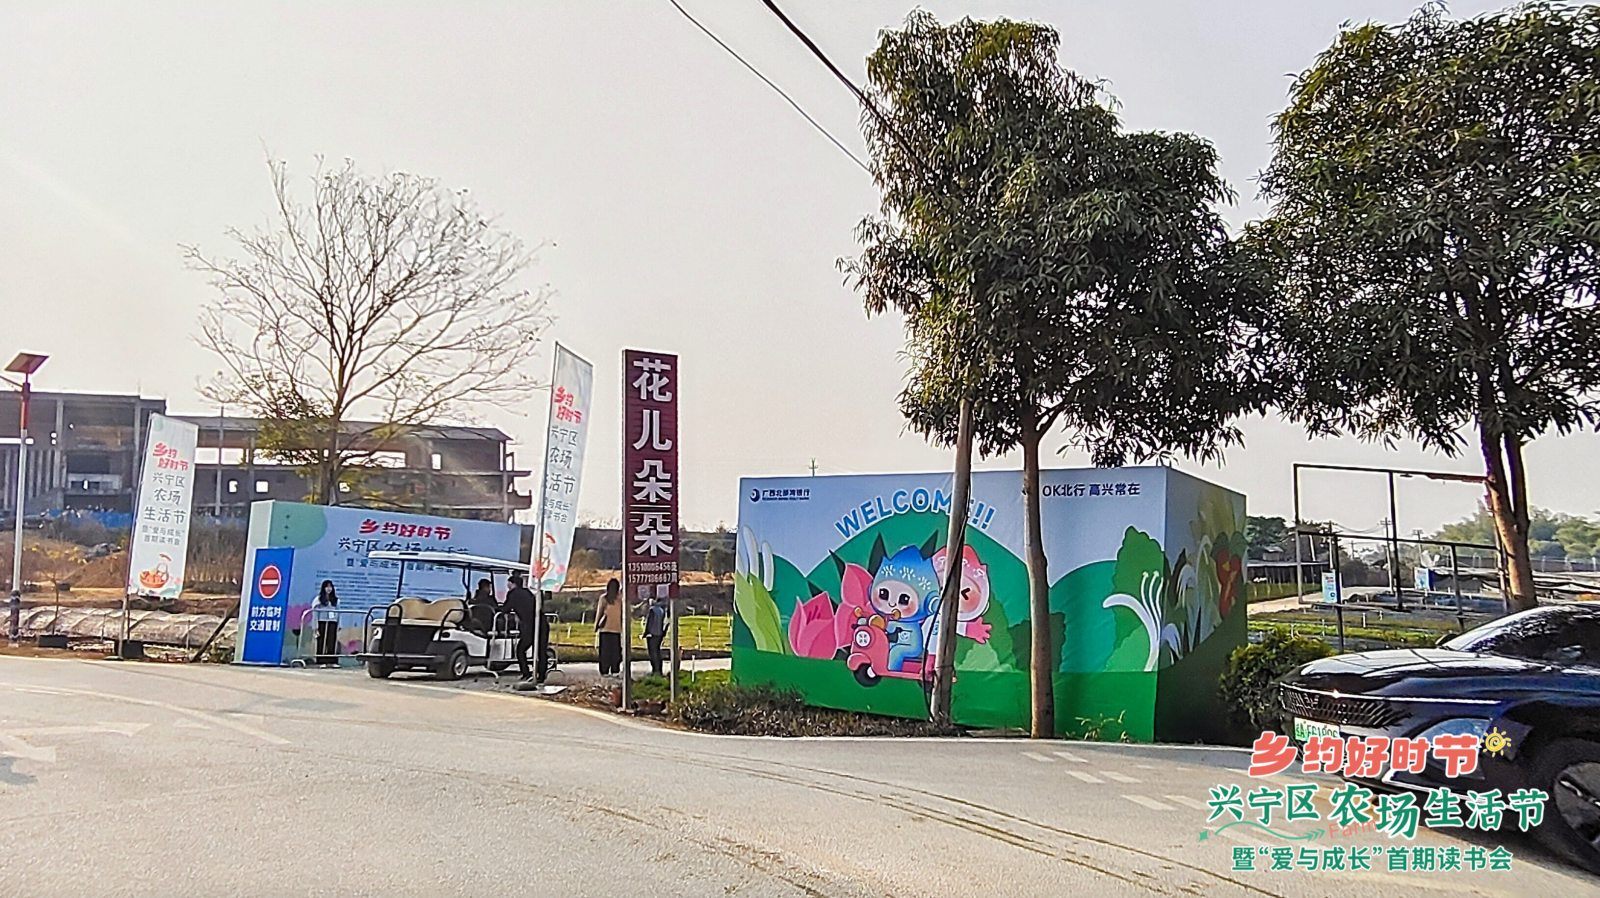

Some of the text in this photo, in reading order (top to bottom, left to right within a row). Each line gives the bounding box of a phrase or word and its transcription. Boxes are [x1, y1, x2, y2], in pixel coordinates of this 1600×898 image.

[153, 442, 177, 458] 乡约
[550, 447, 573, 469] 农场
[633, 357, 674, 557] 花儿朵朵
[158, 458, 189, 471] 好时节
[152, 472, 185, 488] 兴宁区
[154, 488, 181, 505] 农场
[1042, 482, 1141, 497] OK北行 高兴常在
[144, 506, 187, 524] 生活节
[834, 488, 996, 538] WELCOM!!
[359, 519, 451, 540] 乡约好时节
[251, 606, 282, 618] 前方临时
[249, 620, 281, 631] 交通管制
